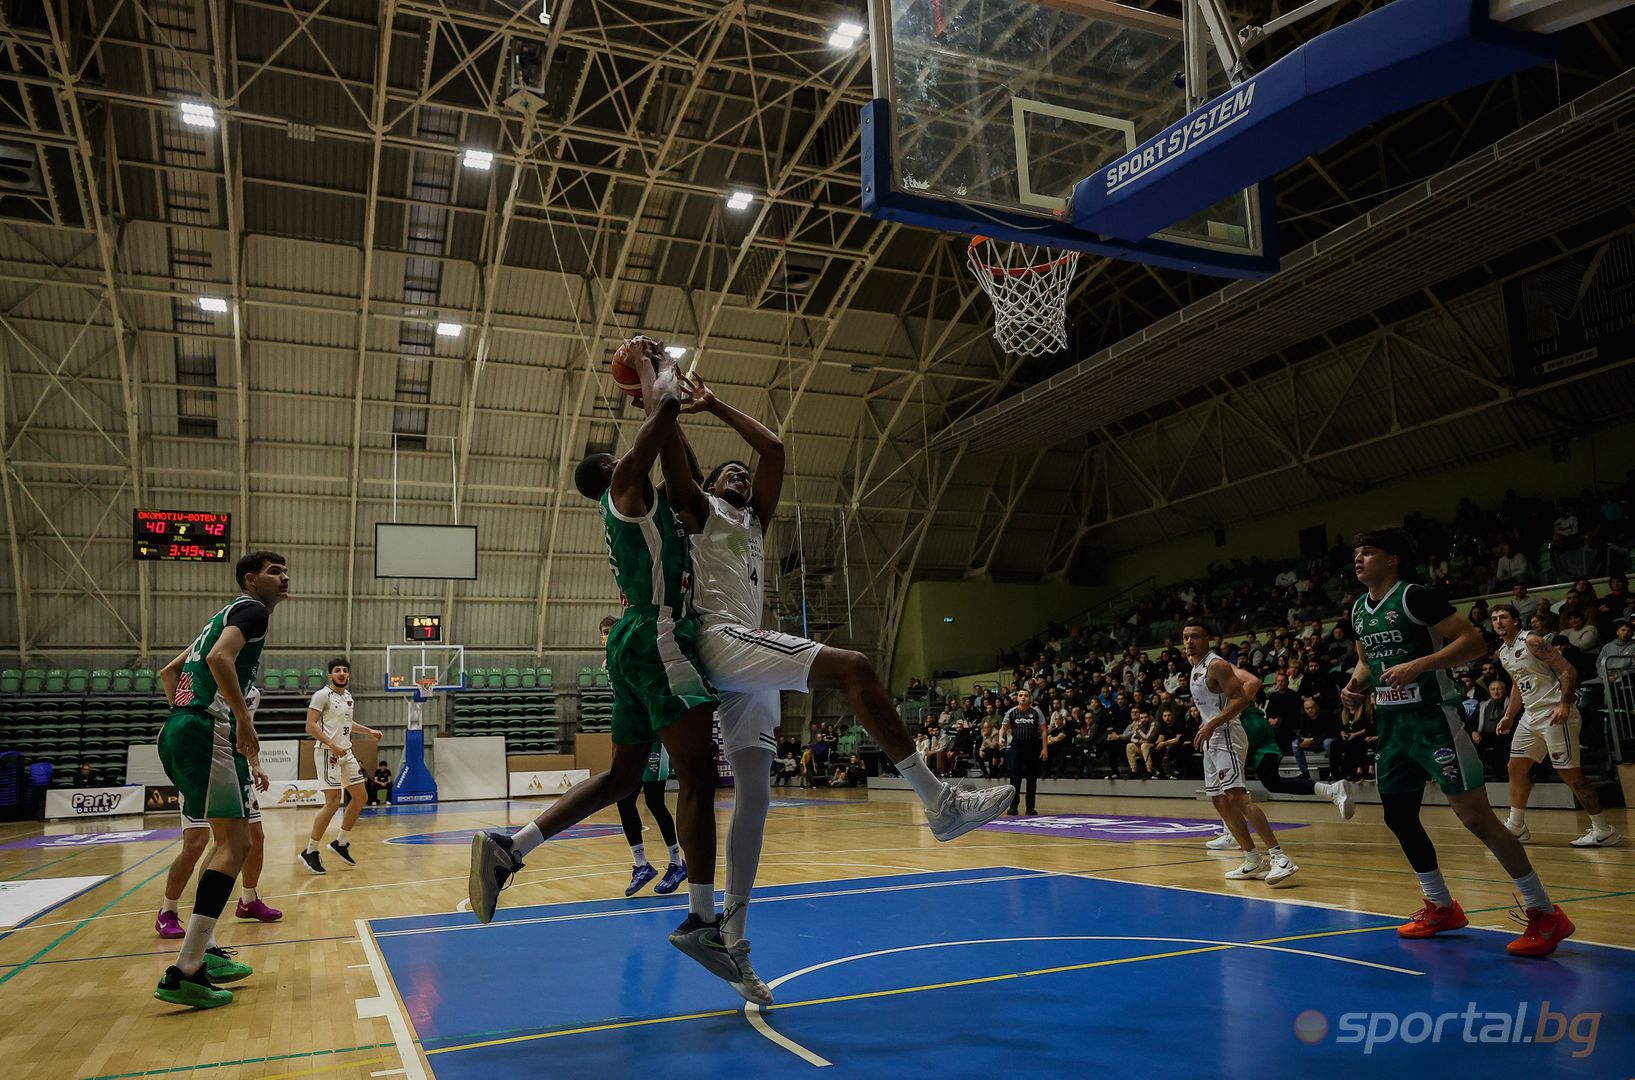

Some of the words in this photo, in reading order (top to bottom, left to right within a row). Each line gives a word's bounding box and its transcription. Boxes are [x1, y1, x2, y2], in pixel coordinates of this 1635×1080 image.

[146, 521, 166, 534] 40
[205, 523, 225, 536] 42
[425, 627, 432, 638] 7
[1519, 680, 1532, 693] 24
[71, 792, 122, 810] Party
[77, 805, 111, 814] DRINKS
